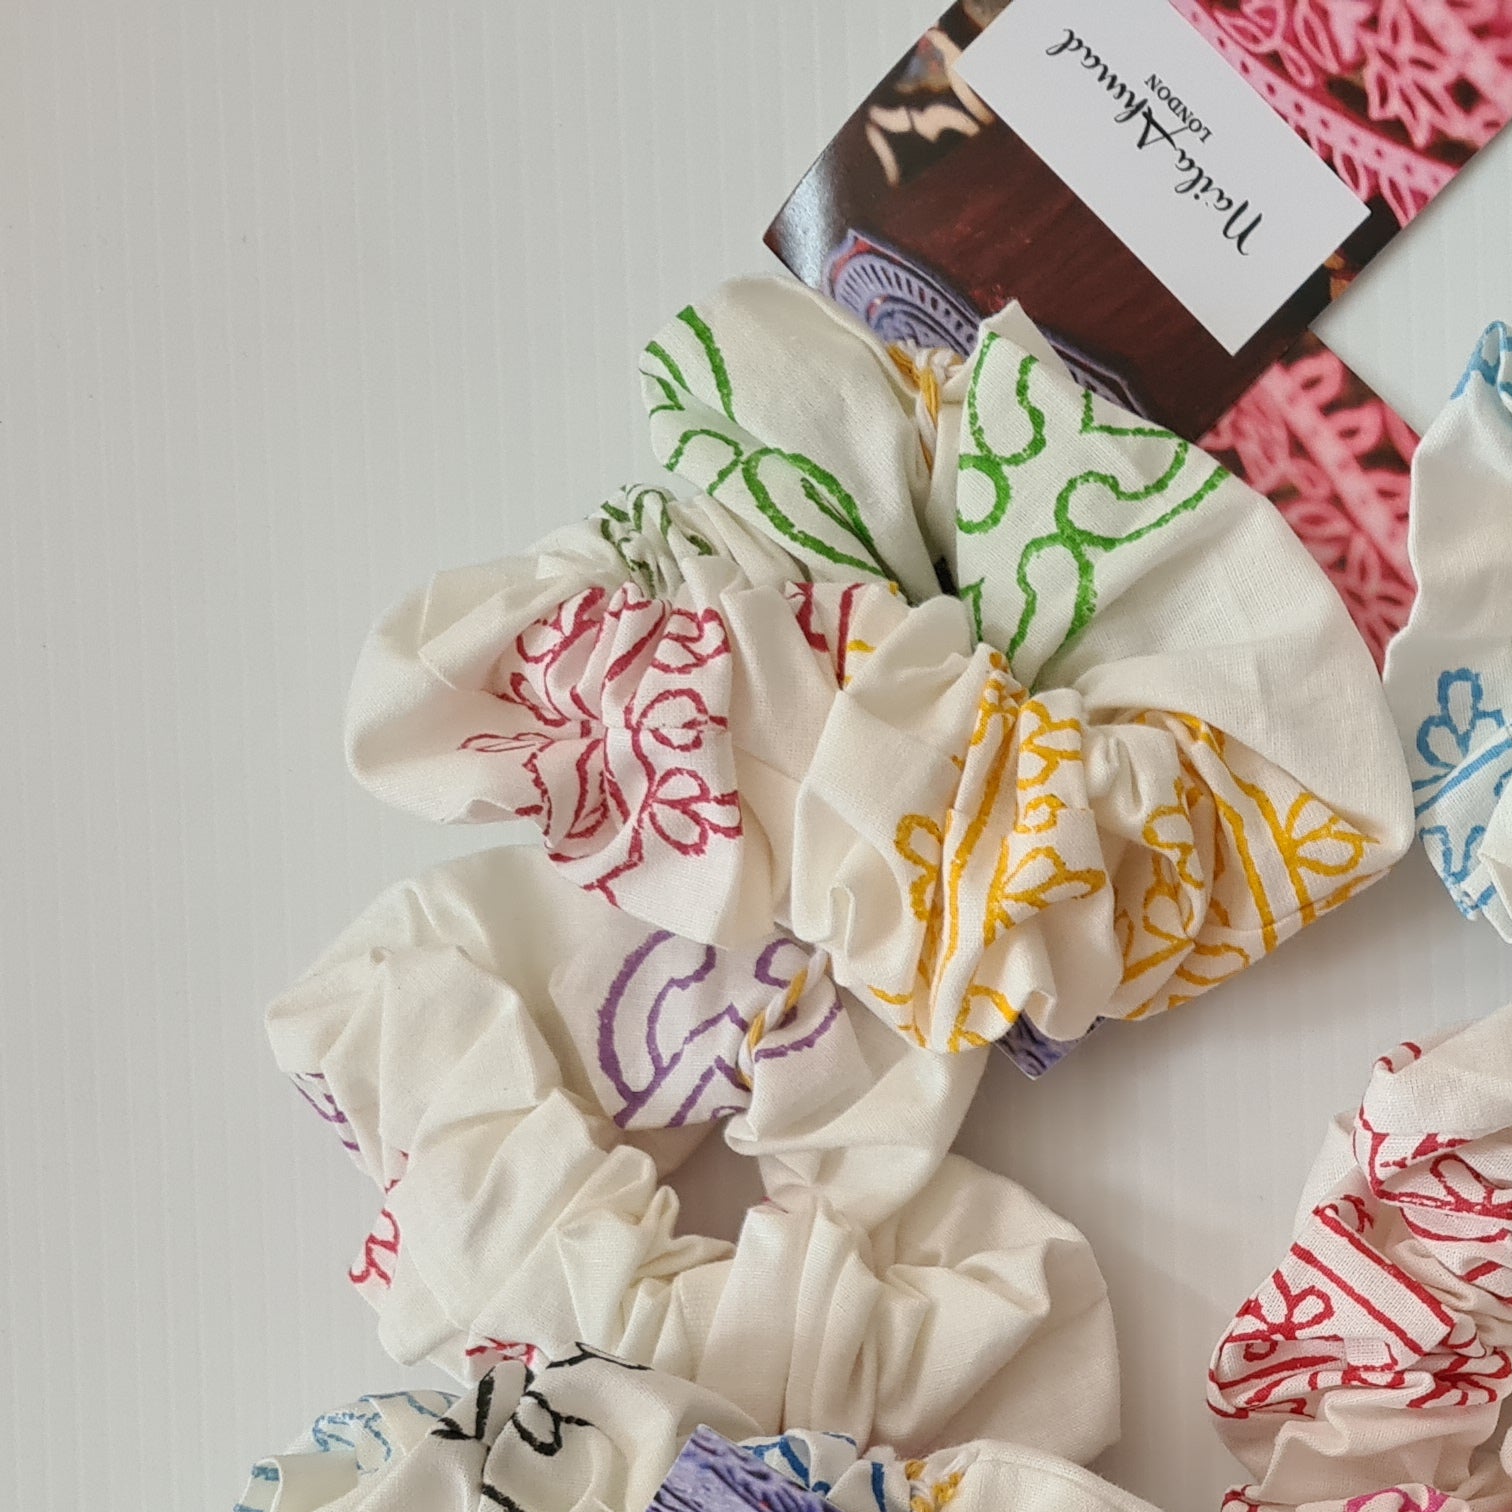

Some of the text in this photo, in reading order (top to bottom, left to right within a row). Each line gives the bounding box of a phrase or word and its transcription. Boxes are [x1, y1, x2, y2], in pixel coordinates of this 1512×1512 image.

[1045, 28, 1264, 257] Naila Ahmad
[1143, 73, 1214, 144] LONDON
